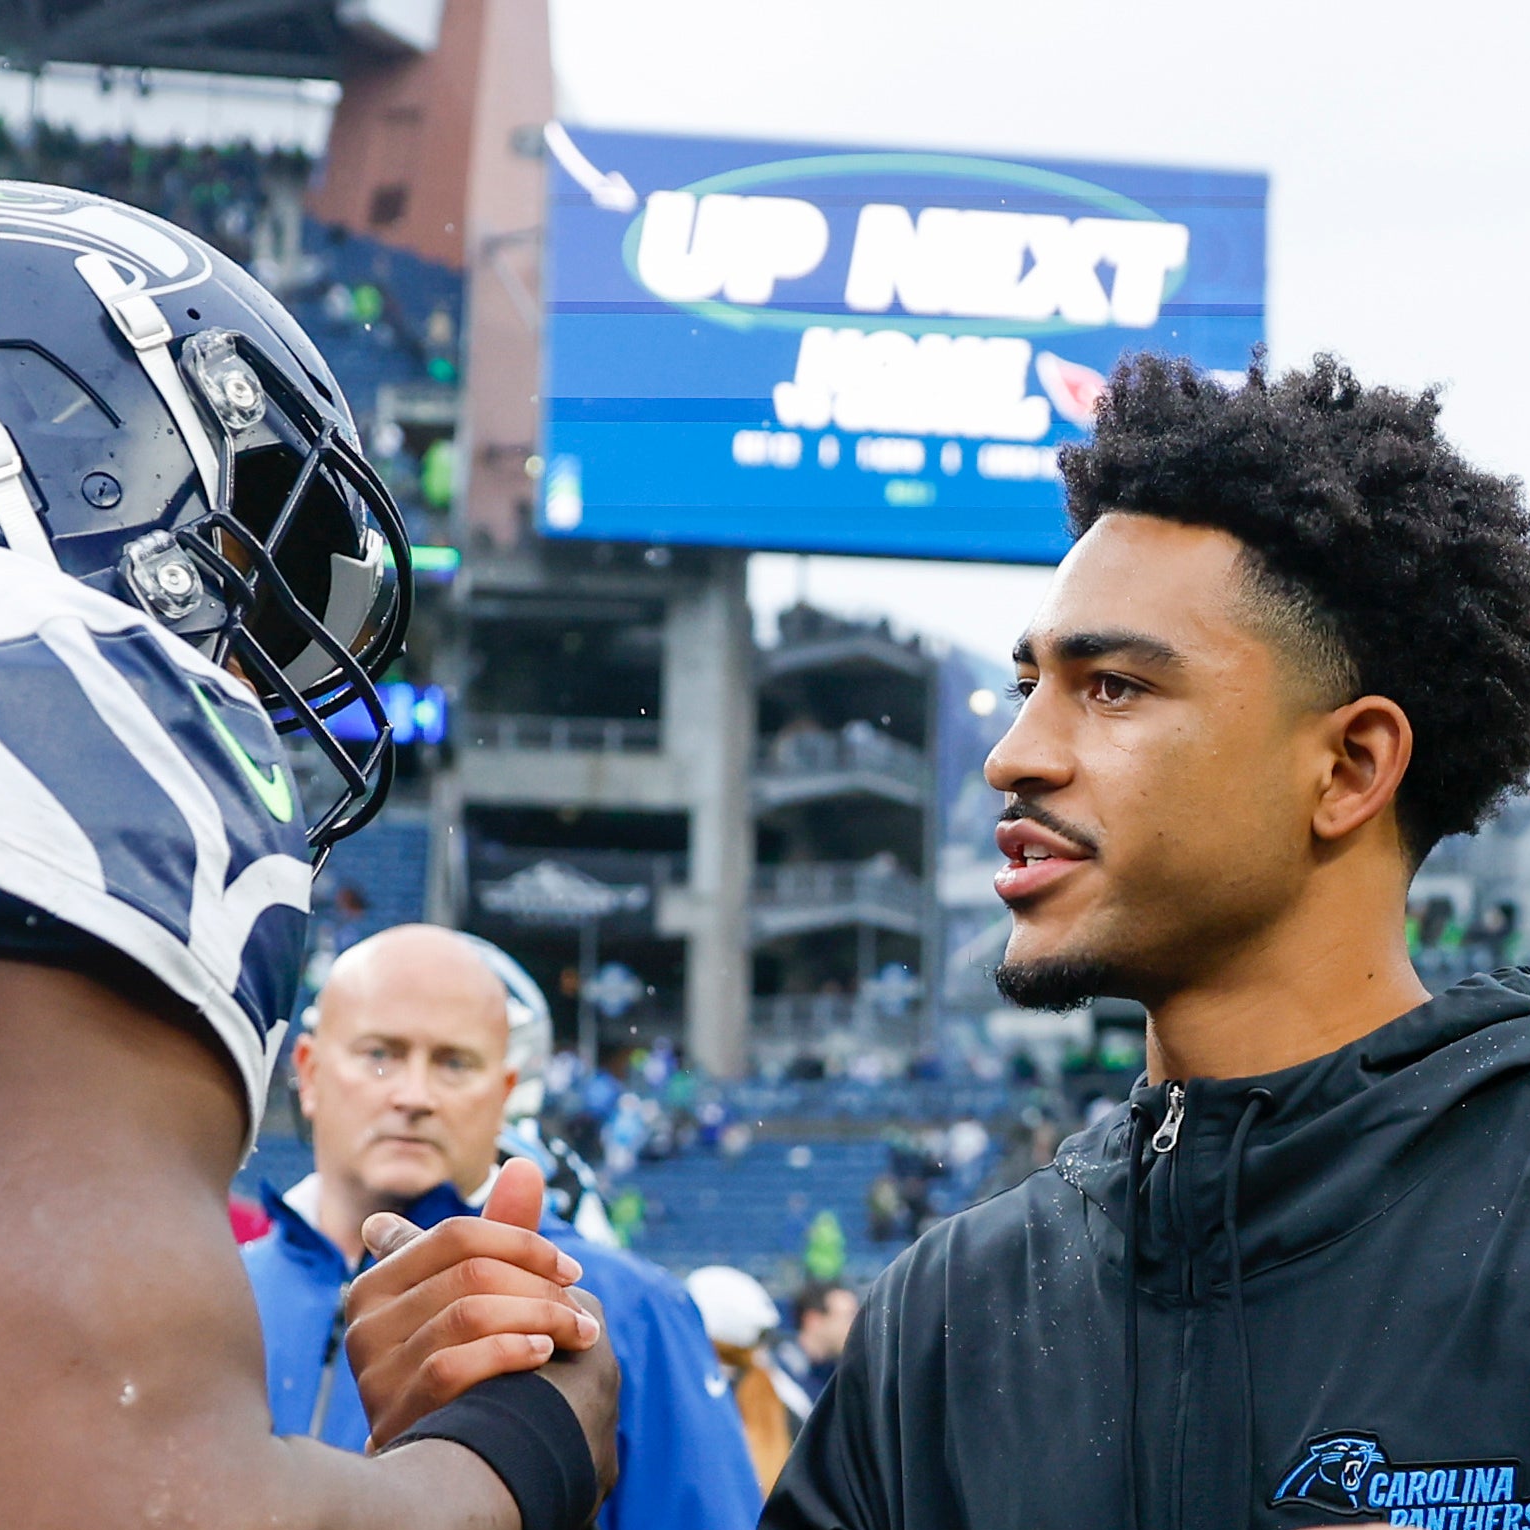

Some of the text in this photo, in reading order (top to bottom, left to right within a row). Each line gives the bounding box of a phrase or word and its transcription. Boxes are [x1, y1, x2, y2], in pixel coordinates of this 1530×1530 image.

[637, 190, 1190, 328] UP NEXT
[1368, 1466, 1516, 1508] CAROLINA
